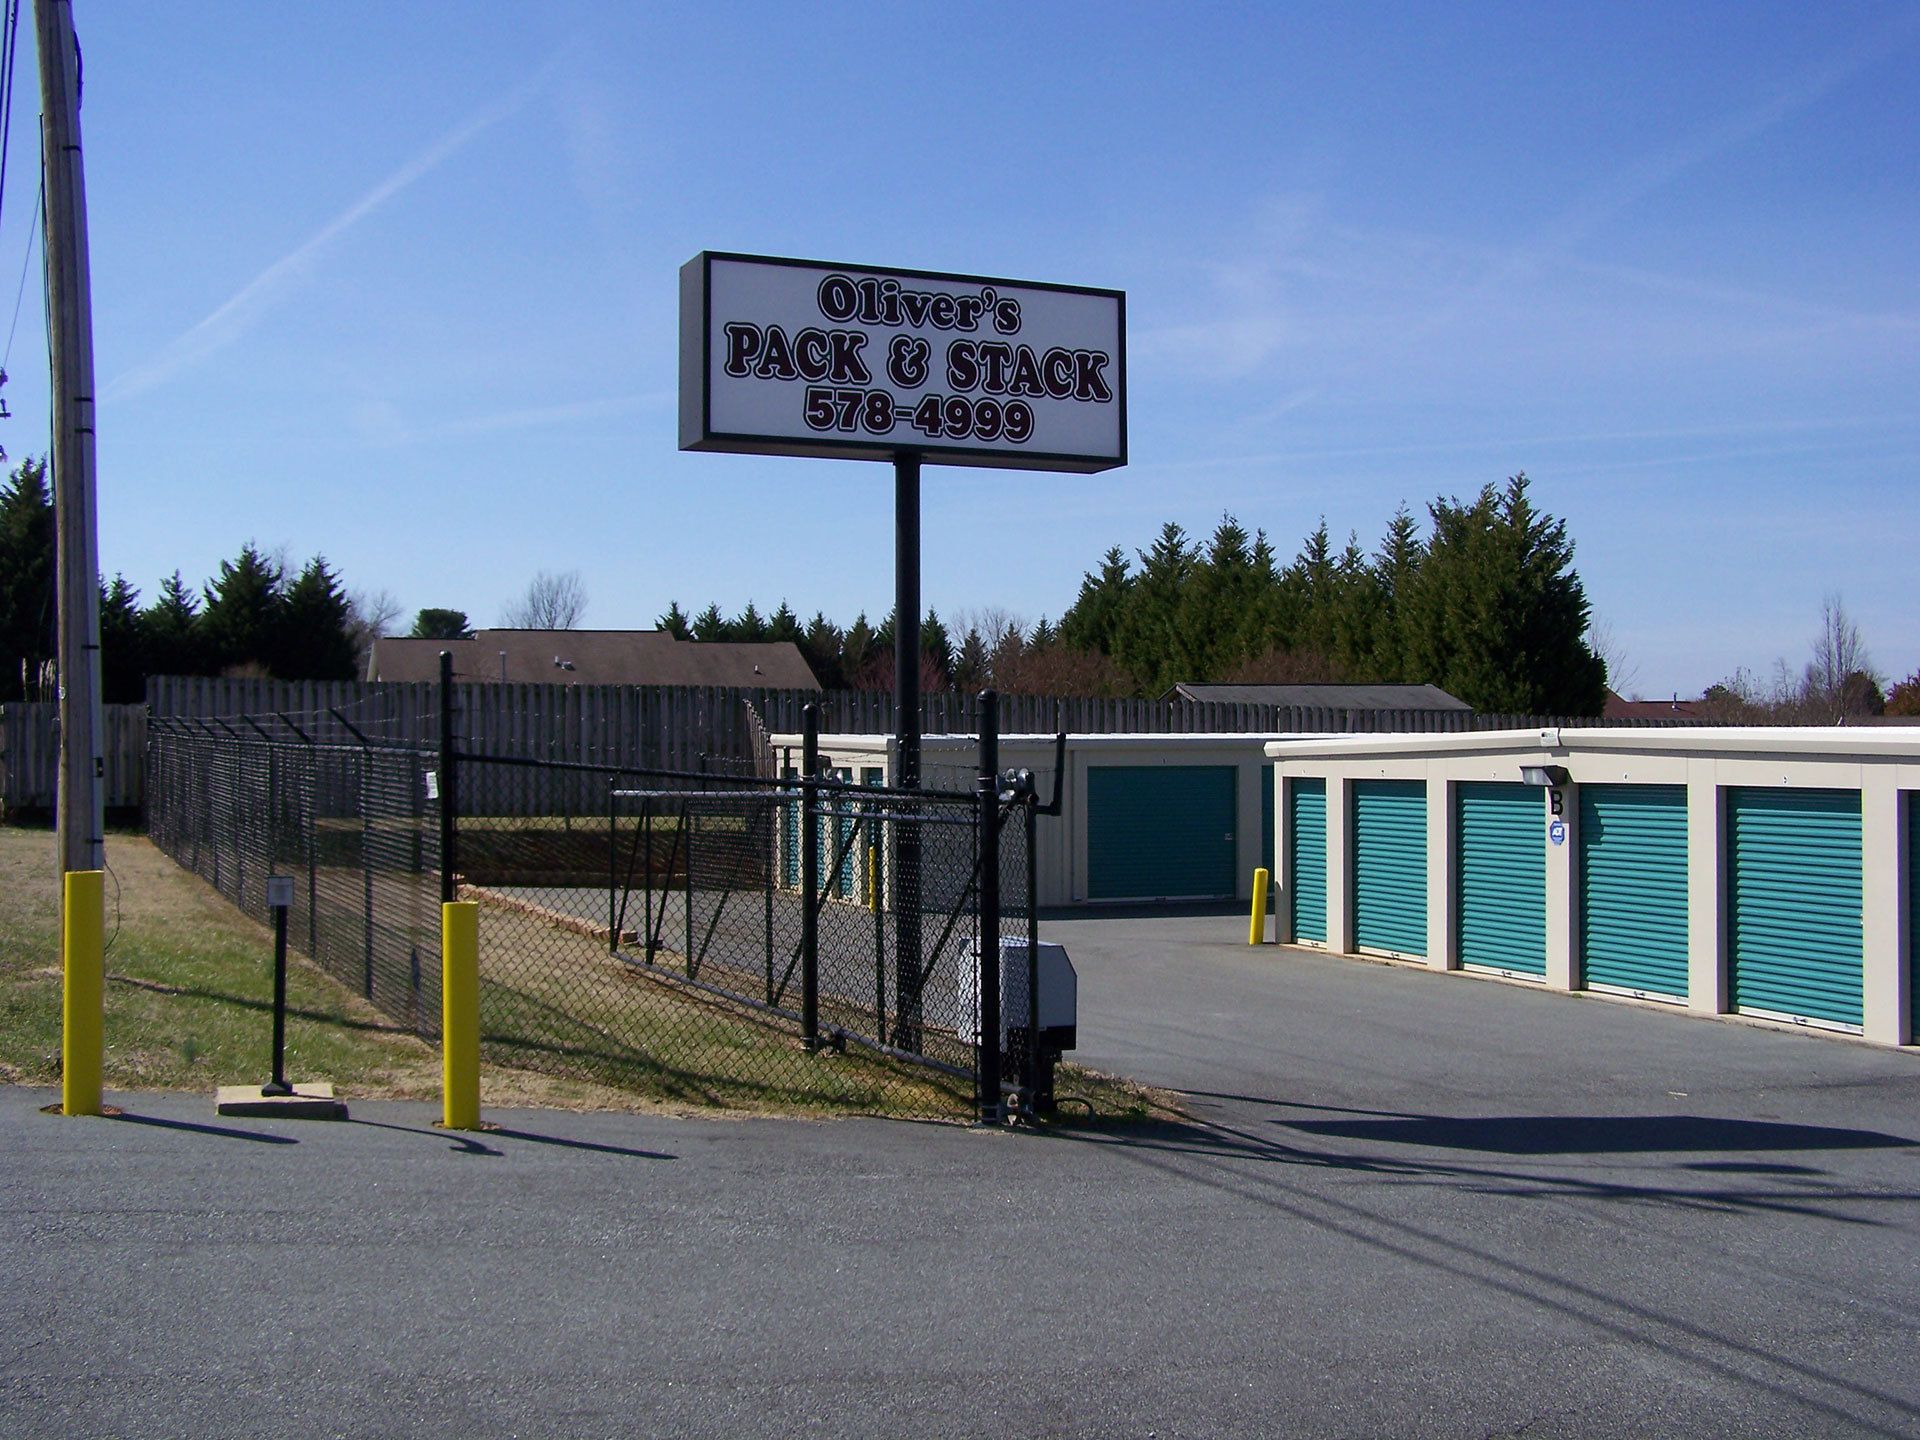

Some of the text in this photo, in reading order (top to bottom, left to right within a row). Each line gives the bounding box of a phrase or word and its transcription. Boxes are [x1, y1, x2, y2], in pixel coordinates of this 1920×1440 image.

[817, 275, 1022, 335] Oliver's
[724, 322, 1112, 402] PACK & STACK
[804, 386, 1034, 443] 578-4999
[1551, 790, 1563, 816] B
